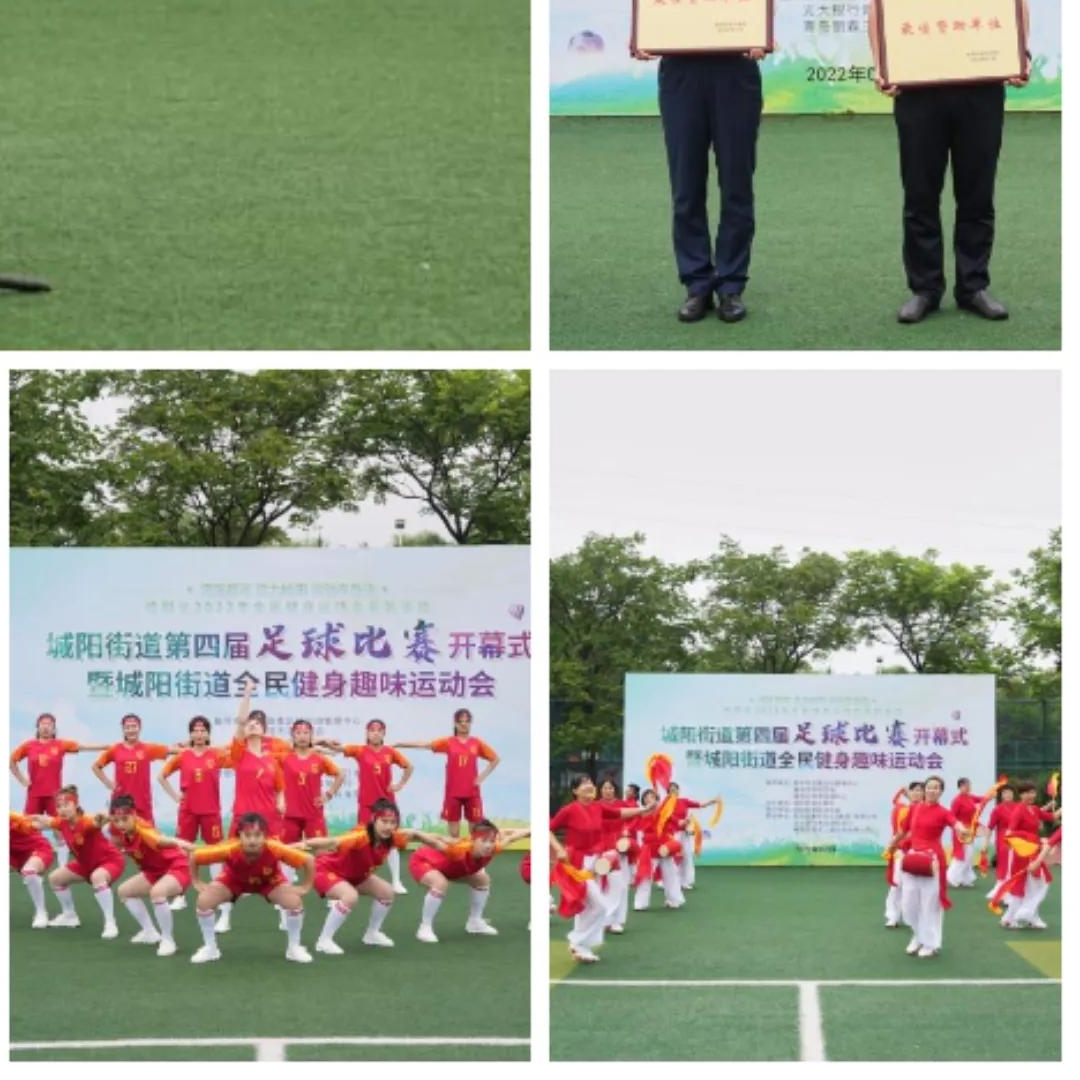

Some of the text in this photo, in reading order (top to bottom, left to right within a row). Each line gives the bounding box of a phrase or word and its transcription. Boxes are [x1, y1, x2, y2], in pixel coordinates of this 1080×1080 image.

[46, 619, 531, 665] 城阳街道第四届 足球比赛 开幕式
[87, 669, 496, 701] 暨城阳街道全民健身趣味运动会
[662, 719, 969, 748] 城阳街道第四届 足球比赛 开幕式
